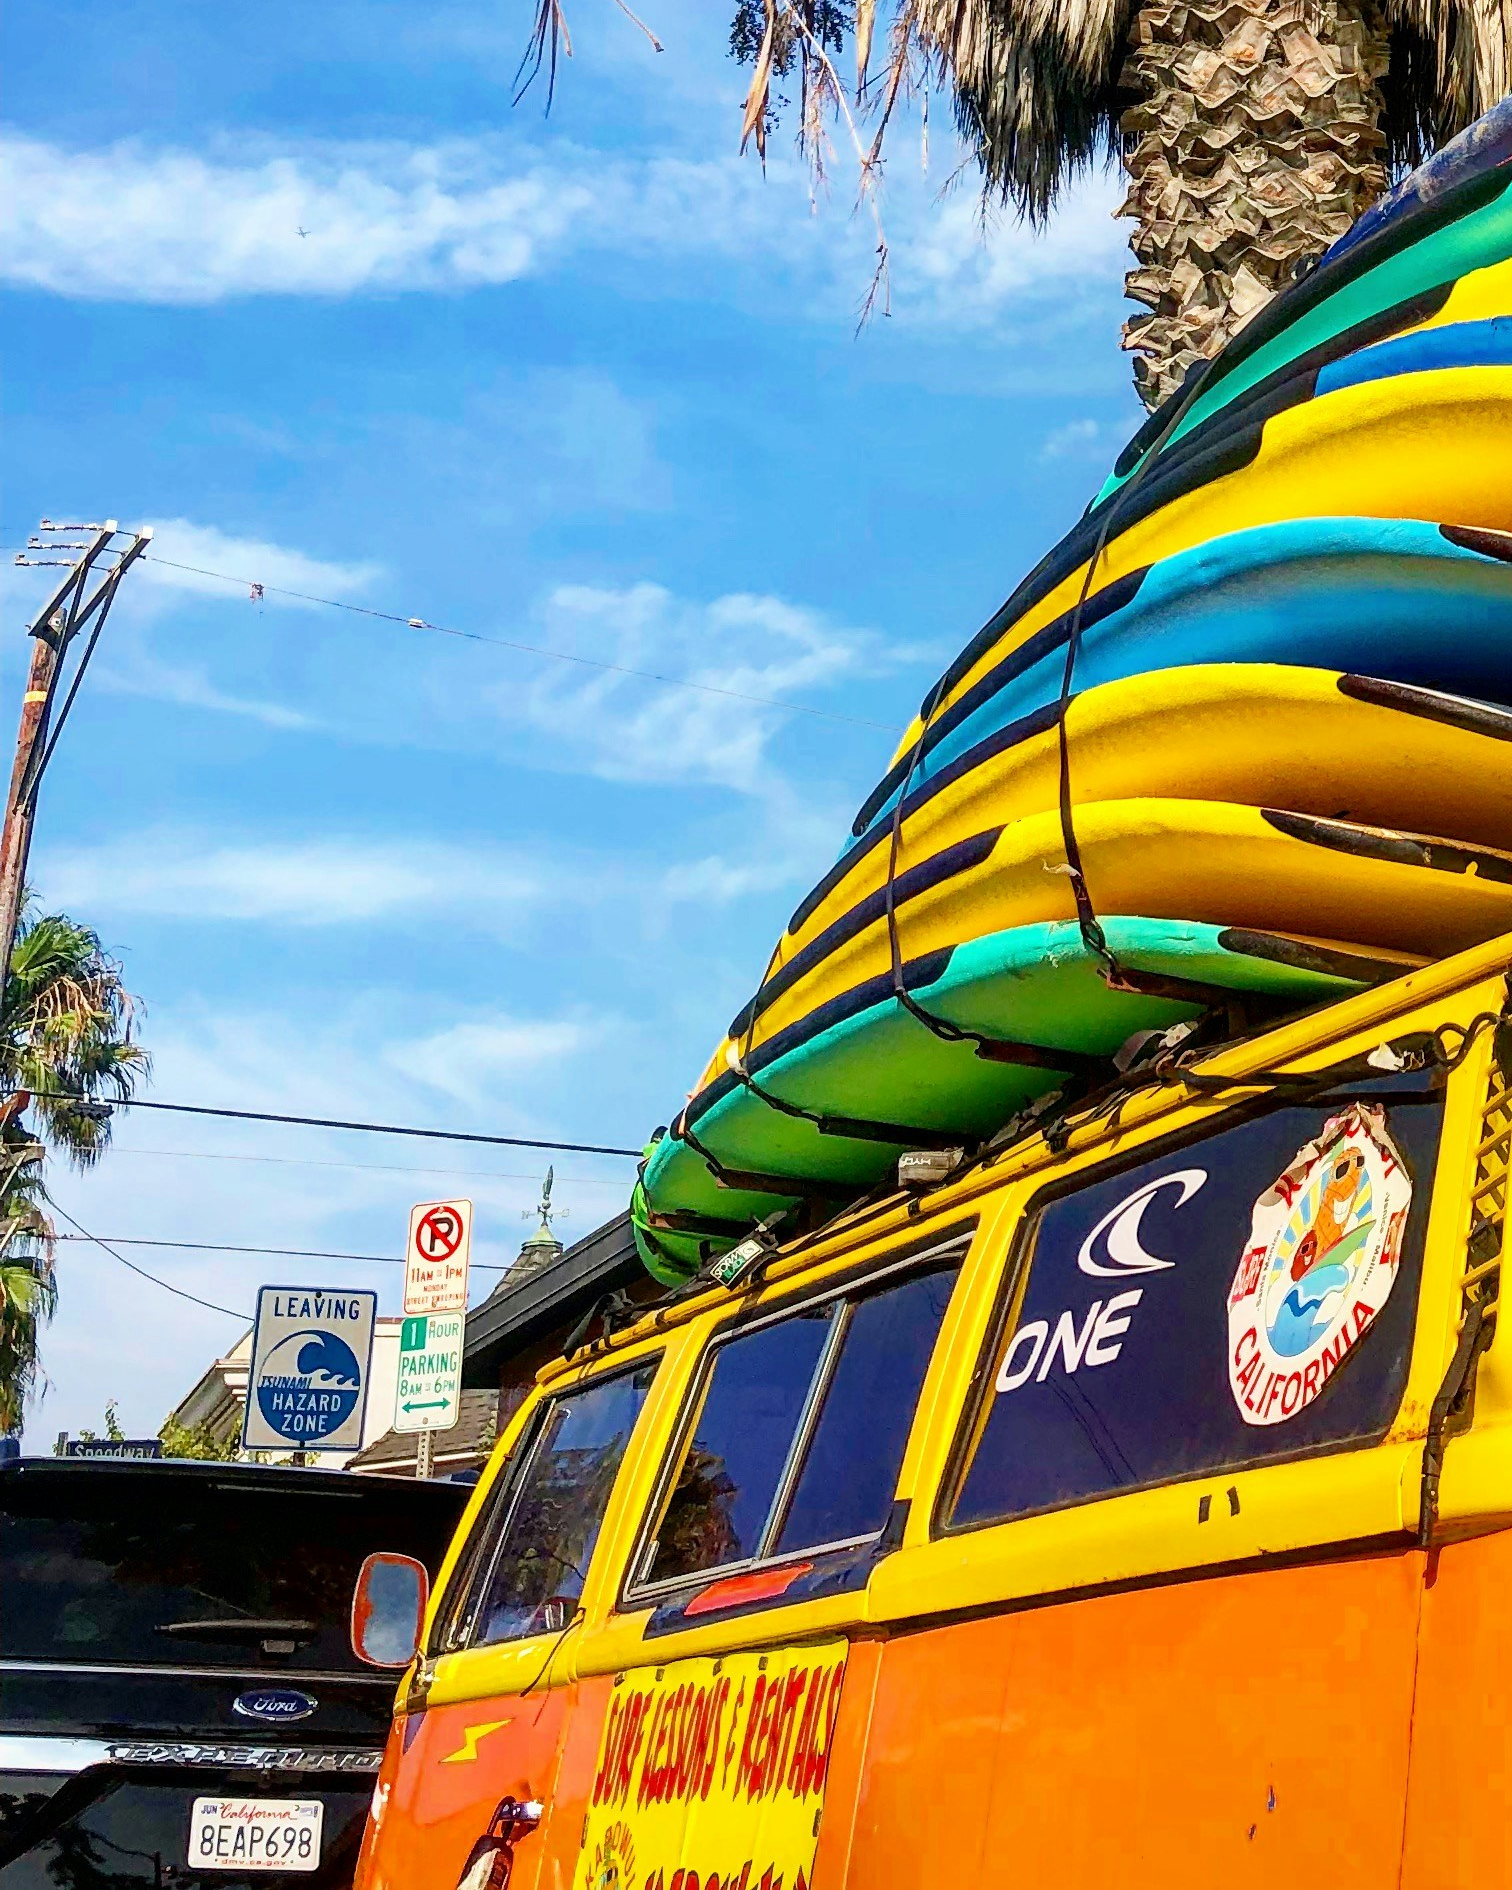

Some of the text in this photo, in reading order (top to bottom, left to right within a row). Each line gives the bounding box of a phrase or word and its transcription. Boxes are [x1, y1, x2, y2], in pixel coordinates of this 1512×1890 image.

[273, 1296, 361, 1320] LEAVING
[410, 1321, 460, 1347] 1 HOUR
[995, 1287, 1144, 1394] ONE
[400, 1350, 458, 1377] PARKING
[1234, 1300, 1376, 1420] CALIFORNIA
[261, 1375, 313, 1390] TSUNAMI
[400, 1378, 423, 1398] 8AM
[434, 1375, 456, 1394] 6PM
[272, 1392, 342, 1412] HAZARD
[280, 1413, 329, 1433] ZONE
[74, 1444, 156, 1459] Speedway
[253, 1696, 298, 1713] Ford
[124, 1744, 383, 1768] EXPEDITIO
[592, 1688, 656, 1812] SURF
[221, 1802, 298, 1825] California
[199, 1824, 313, 1859] 8EAP698
